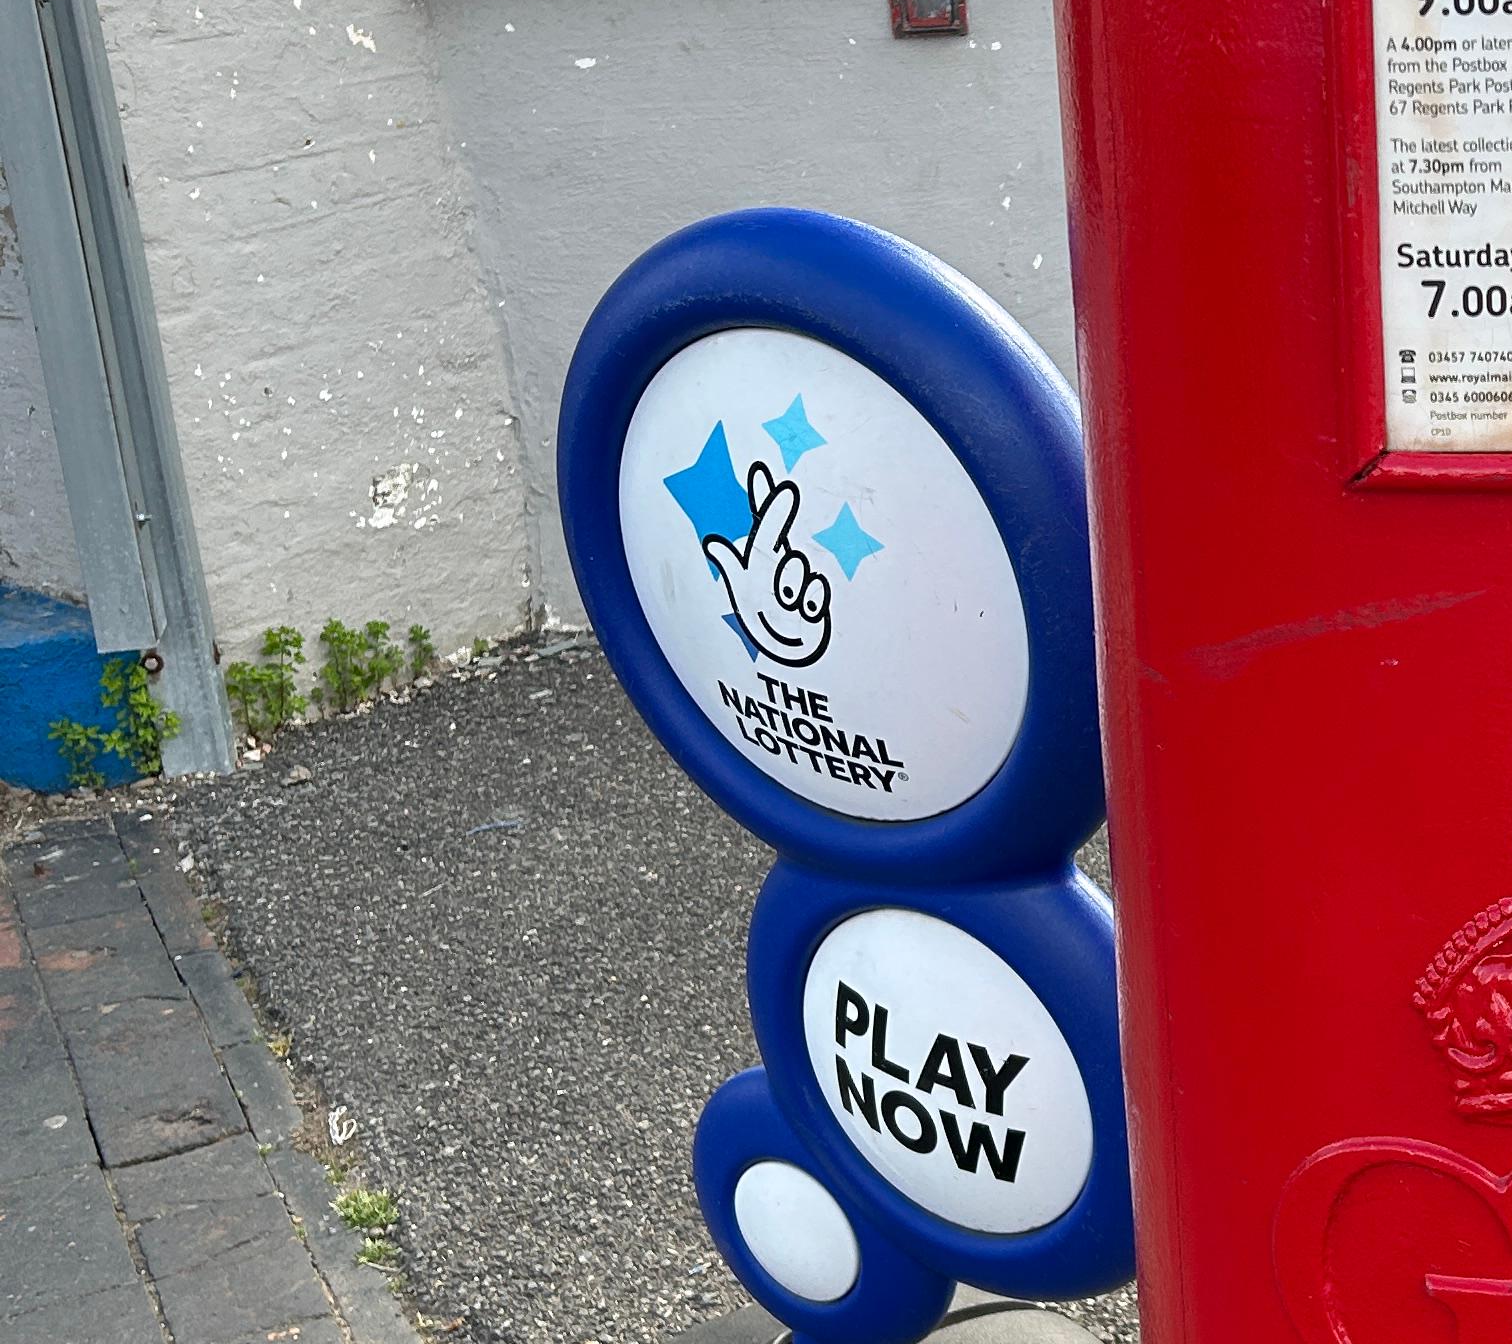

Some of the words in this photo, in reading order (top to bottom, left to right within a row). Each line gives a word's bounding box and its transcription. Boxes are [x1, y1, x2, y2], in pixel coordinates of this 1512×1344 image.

[1386, 38, 1397, 52] A
[1400, 37, 1458, 55] 4.00pm
[1461, 38, 1478, 51] or
[1387, 58, 1421, 73] from
[1425, 58, 1448, 73] the
[1452, 57, 1507, 72] Postbox
[1388, 80, 1445, 97] Regents
[1449, 78, 1481, 94] Park
[1389, 101, 1408, 116] 67
[1412, 99, 1469, 119] Regents
[1473, 100, 1505, 115] Park
[1391, 138, 1417, 154] The
[1421, 137, 1459, 153] latest
[1391, 161, 1406, 174] at
[1408, 159, 1465, 177] 7.30pm
[1469, 158, 1503, 173] from
[1391, 179, 1486, 198] Southampton
[1392, 199, 1446, 215] Mitchell
[1449, 200, 1478, 218] Way
[1428, 351, 1465, 363] 03457
[1430, 392, 1459, 403] 0345
[757, 672, 834, 723] THE
[718, 680, 904, 769] NATIONAL
[735, 715, 894, 793] LOTTERY
[835, 980, 1031, 1117] PLAY
[835, 1054, 1026, 1184] NOW
